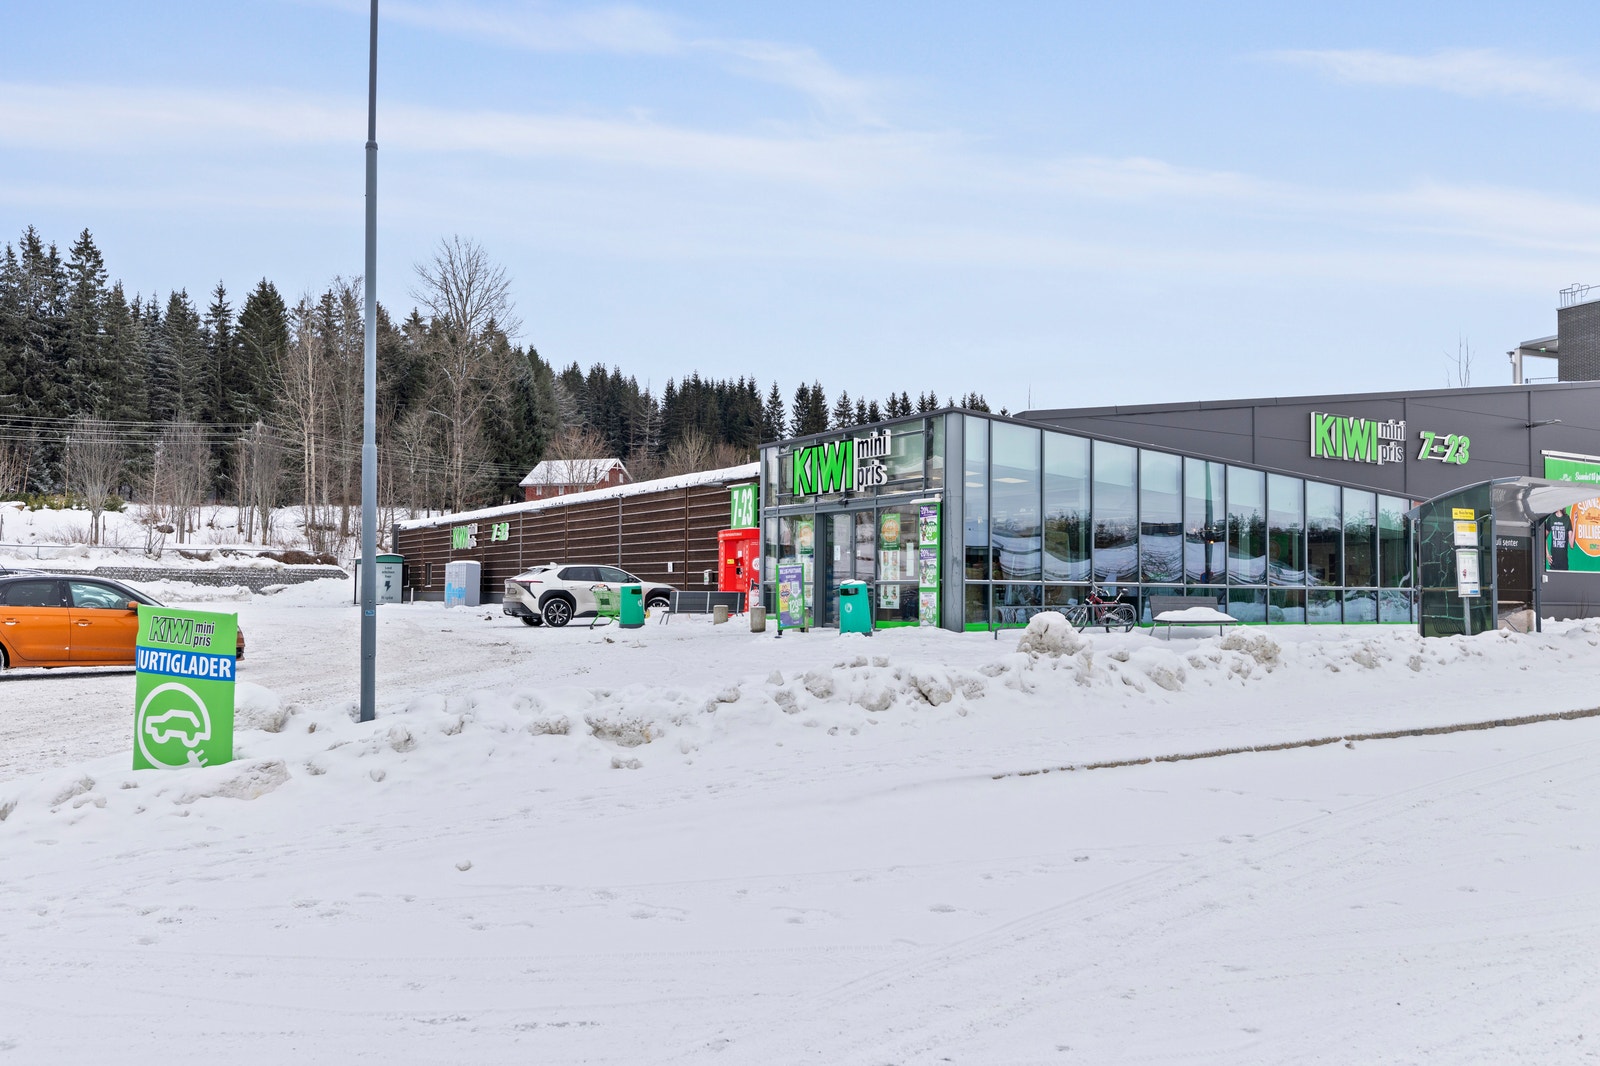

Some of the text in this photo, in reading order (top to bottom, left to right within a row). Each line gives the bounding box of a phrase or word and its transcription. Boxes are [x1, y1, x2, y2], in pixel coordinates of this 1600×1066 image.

[1311, 411, 1406, 464] KIWI mini
[1377, 441, 1404, 465] pris
[1418, 431, 1470, 465] 7-23
[793, 429, 891, 496] KIWI mini
[857, 460, 887, 492] pris
[733, 488, 753, 527] 7-23
[149, 616, 215, 645] KIWI mini
[193, 634, 211, 648] pris
[137, 648, 232, 678] URTIGLADER
